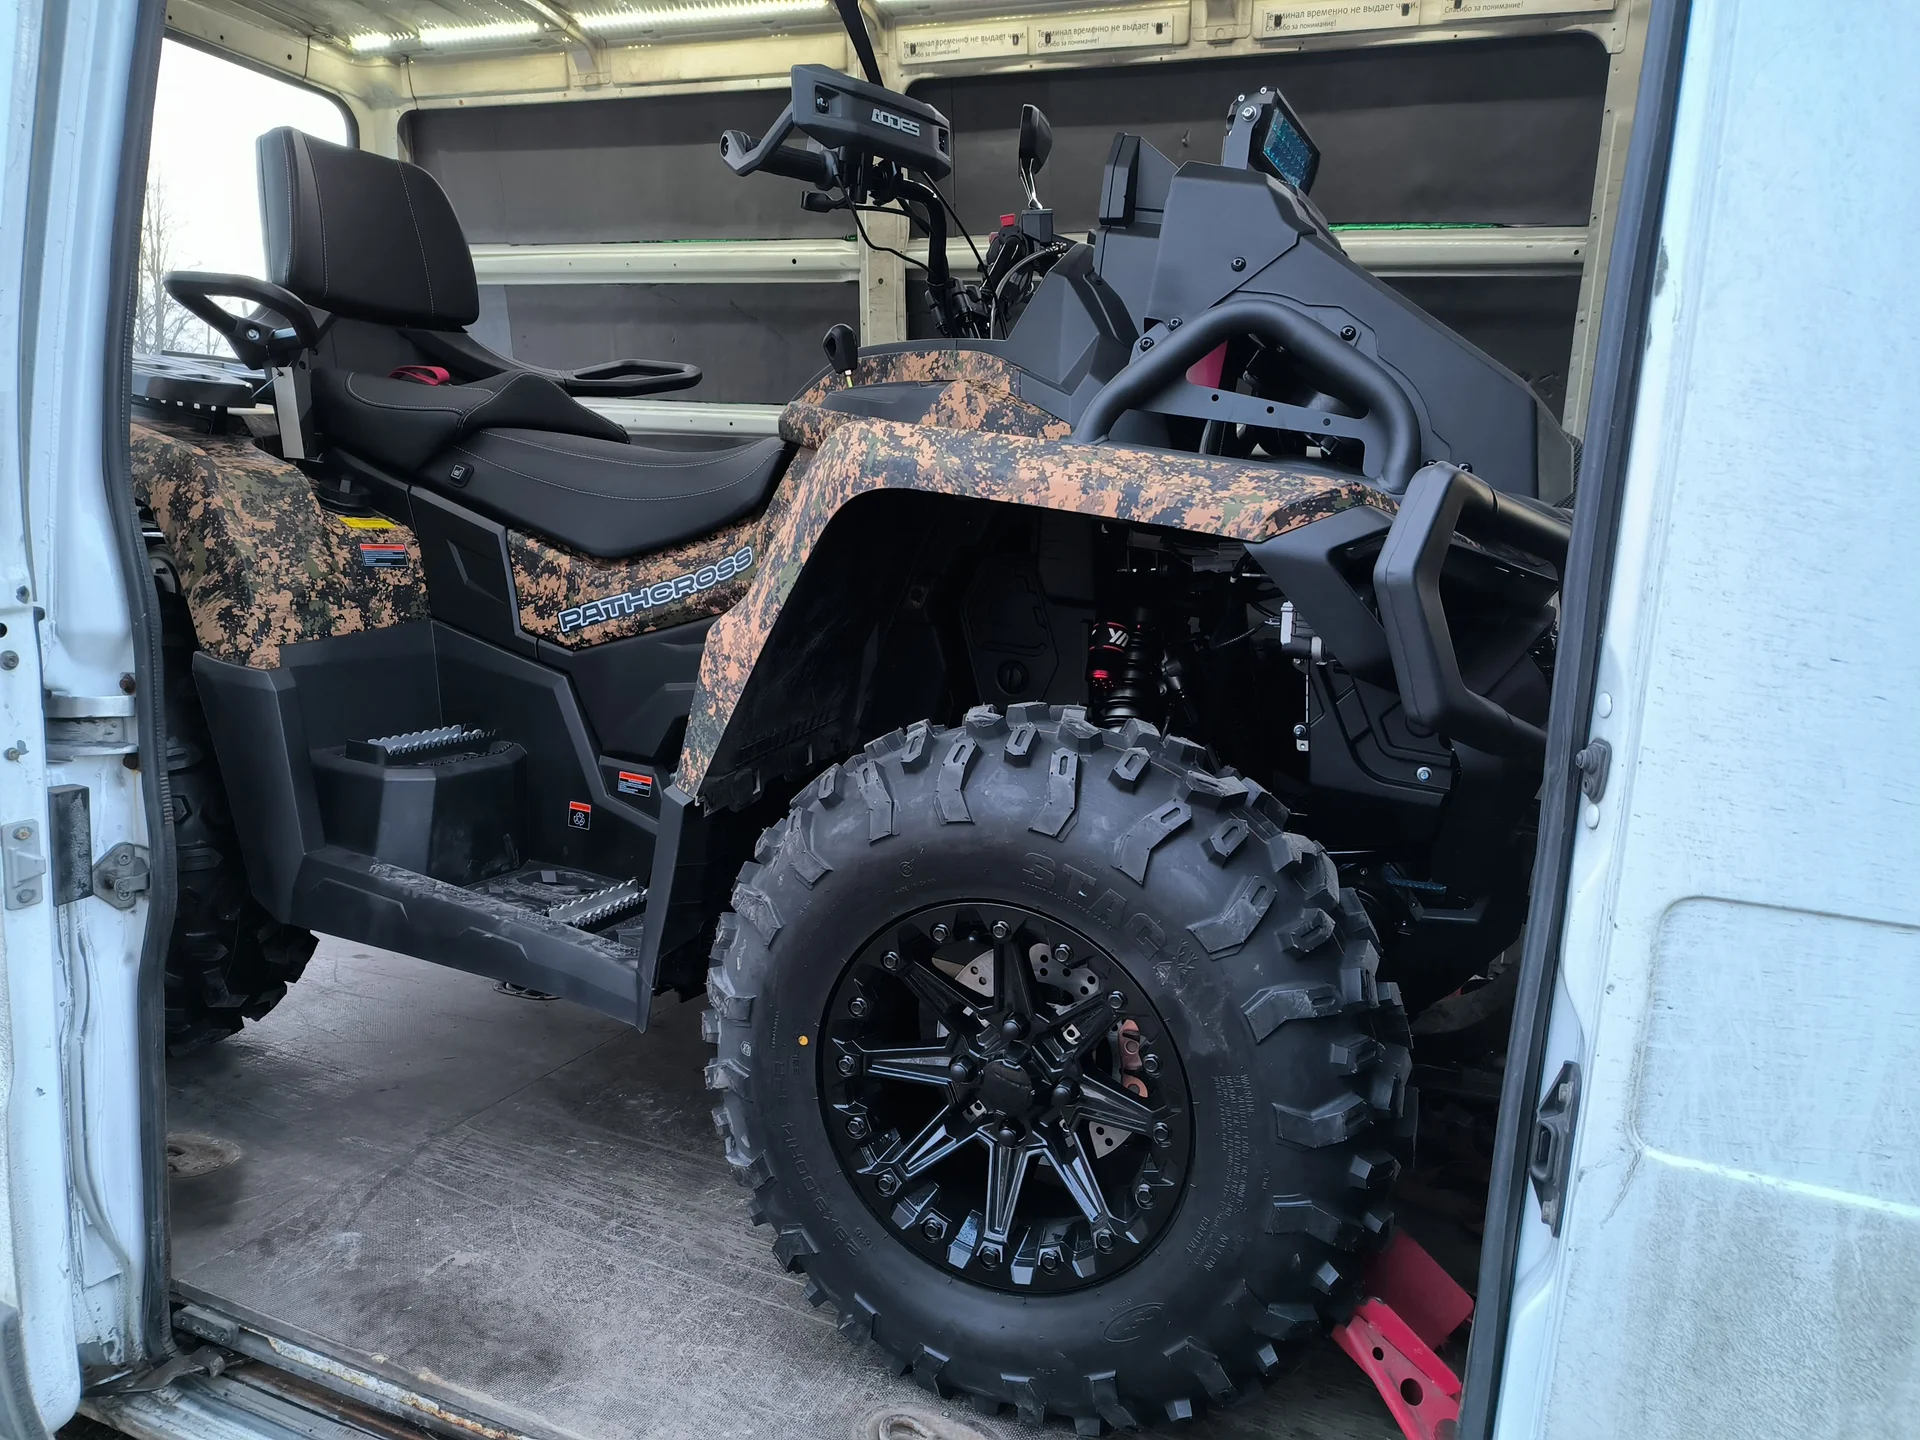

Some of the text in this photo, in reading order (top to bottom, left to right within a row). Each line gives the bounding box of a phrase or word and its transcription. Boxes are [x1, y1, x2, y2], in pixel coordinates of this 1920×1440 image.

[1306, 7, 1348, 19] временно
[1350, 5, 1361, 14] не
[1363, 3, 1394, 13] выдает
[1395, 2, 1418, 10] чи.
[1482, 1, 1524, 11] понимание!
[1073, 25, 1109, 36] временно
[1111, 24, 1120, 32] не
[1122, 22, 1149, 32] выдает
[1299, 19, 1337, 29] понимание!
[936, 36, 968, 49] временно
[980, 34, 1006, 43] выдает
[1007, 32, 1026, 40] чи.
[871, 108, 920, 137] AODES
[557, 545, 754, 633] PATHCROSS
